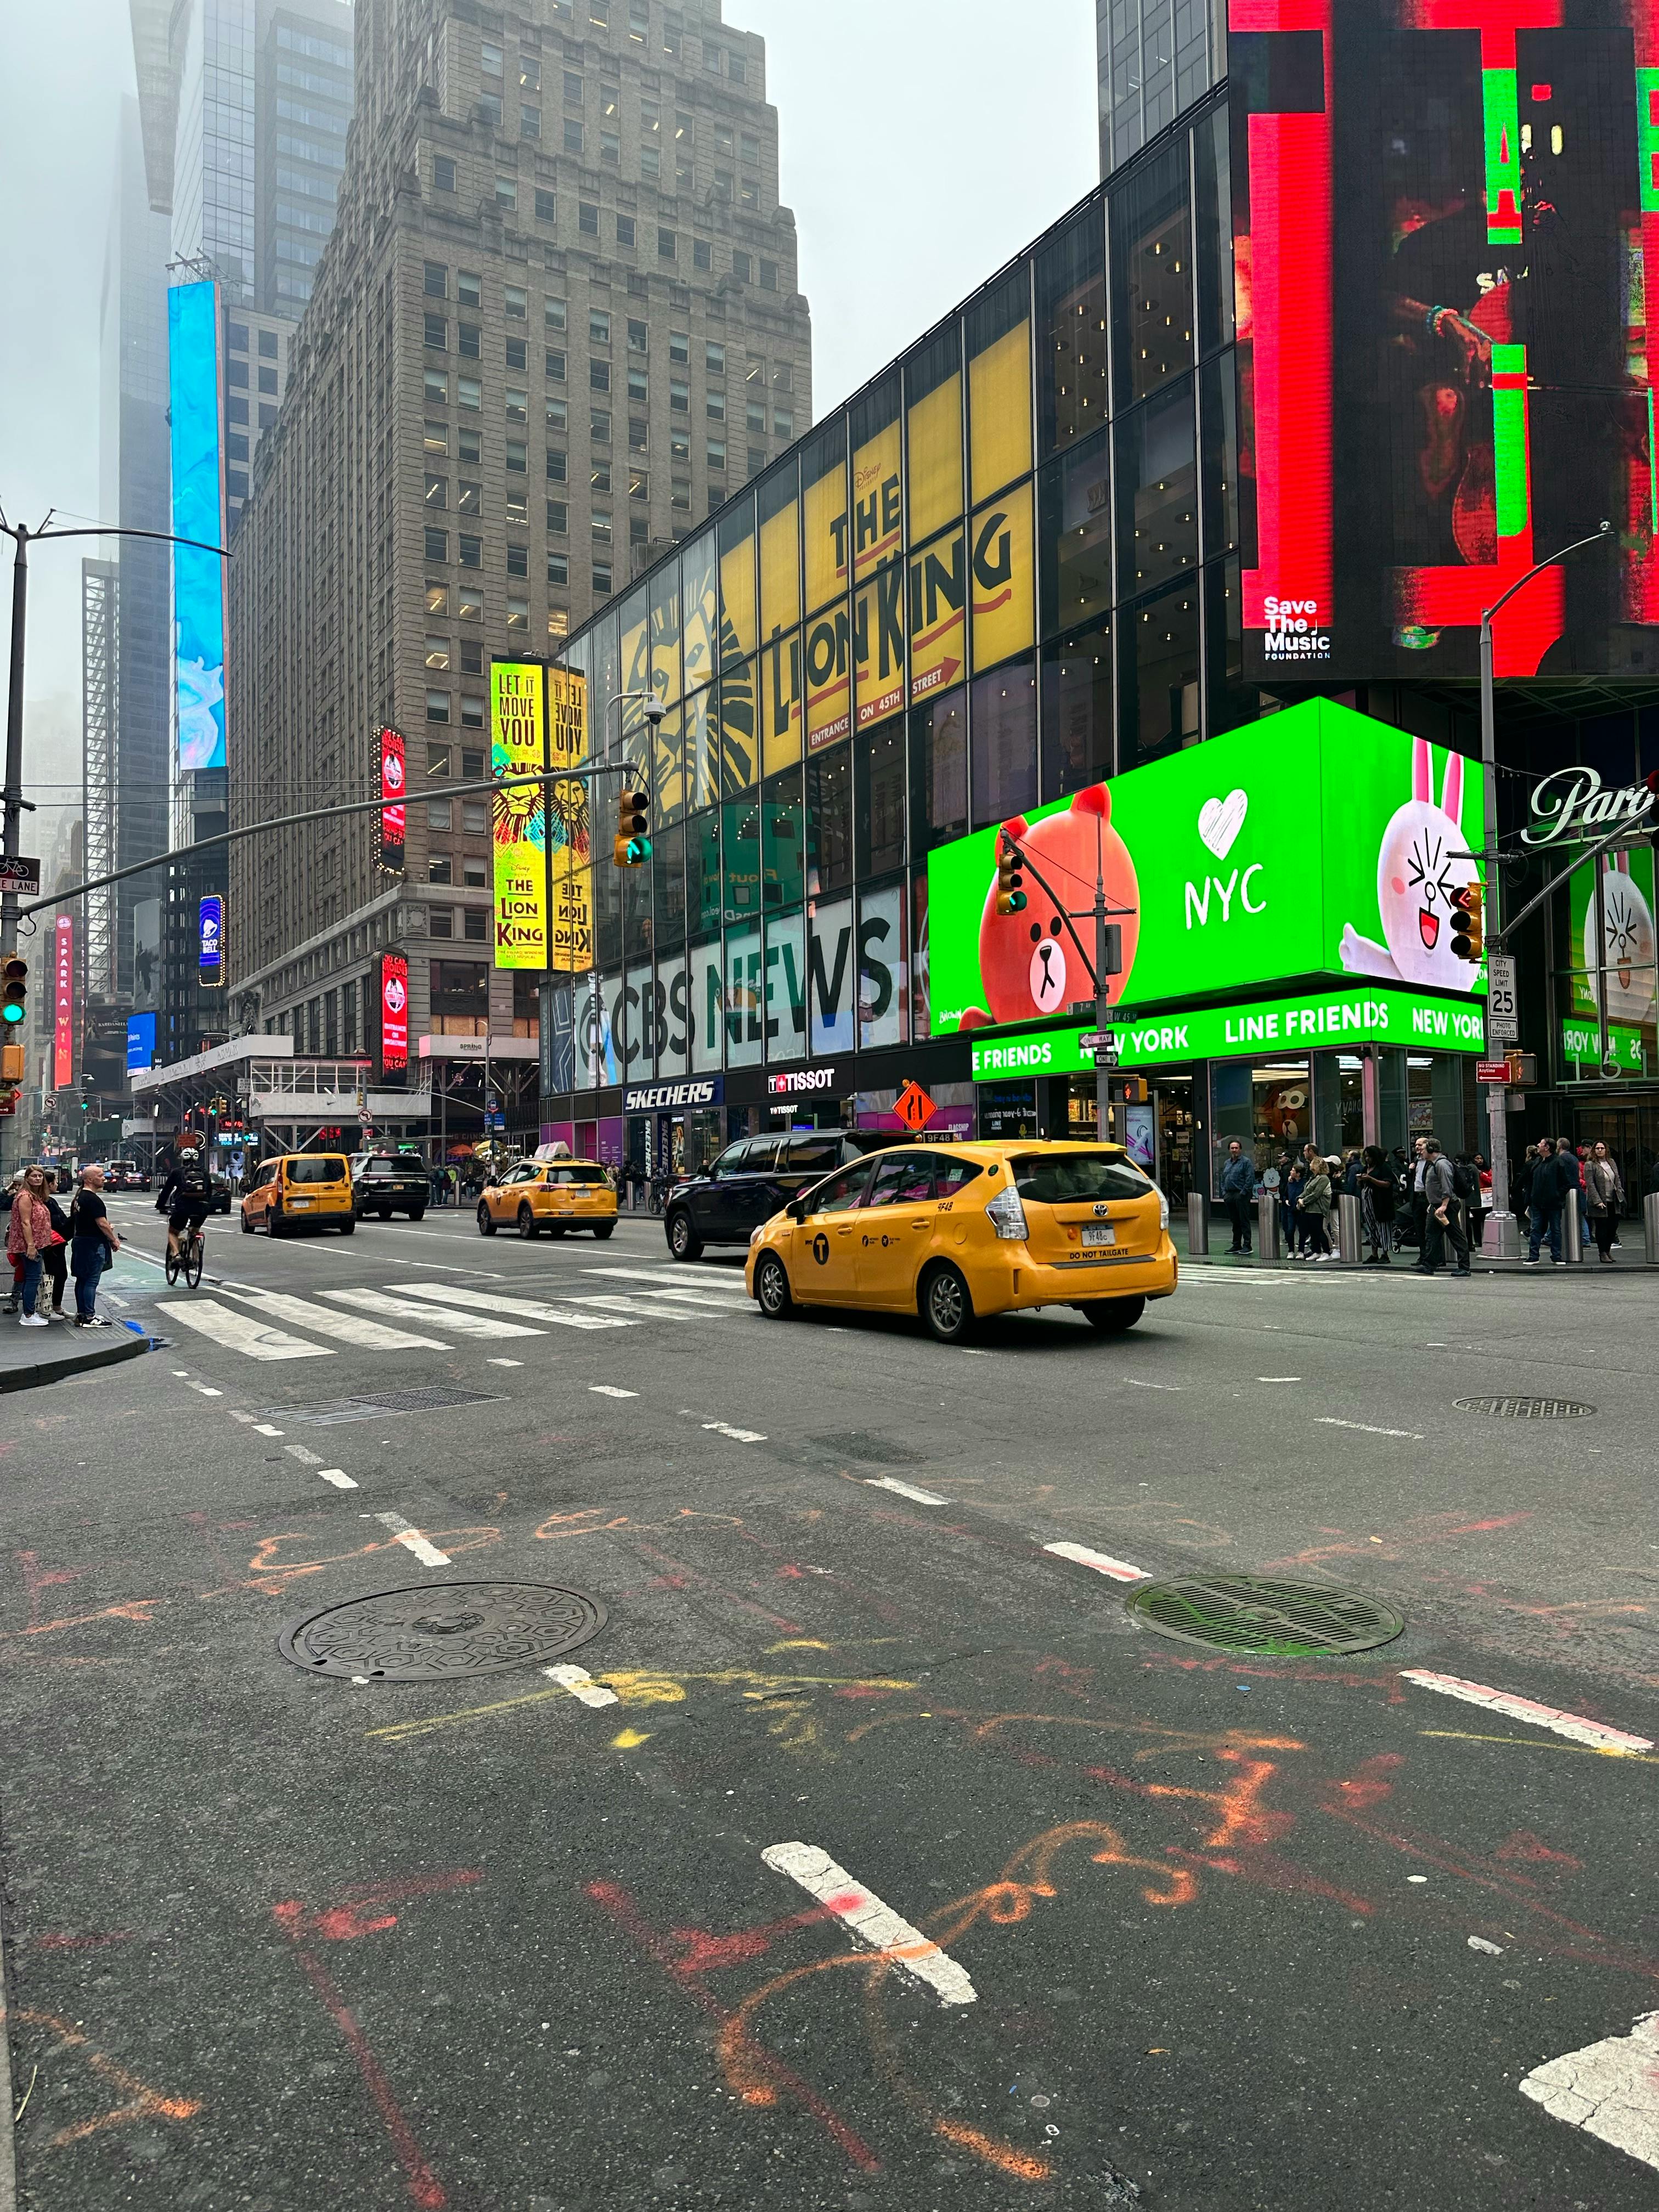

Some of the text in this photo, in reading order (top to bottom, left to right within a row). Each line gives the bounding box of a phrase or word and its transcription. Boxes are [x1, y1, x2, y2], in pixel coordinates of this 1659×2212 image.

[830, 473, 900, 569] THE
[1264, 597, 1317, 614] Save
[774, 512, 1012, 737] LION KING
[1264, 615, 1308, 633] The
[1264, 633, 1330, 651] Music
[499, 674, 534, 695] LET IT
[499, 696, 534, 718] MOVE
[811, 669, 942, 746] ENTRANCE ON 45TH STREET
[500, 718, 534, 747] YOU
[12, 881, 36, 891] LANE
[506, 879, 533, 892] THE
[1184, 863, 1267, 930] NYC
[501, 898, 538, 919] LION
[201, 939, 218, 947] TACO
[497, 922, 543, 947] KING
[202, 946, 218, 954] BELL
[1493, 969, 1509, 978] SPEED
[58, 937, 69, 1060] SPARK A WIN
[612, 917, 892, 1065] CBS NEWS
[1080, 1003, 1084, 1012] 7
[1492, 990, 1513, 1013] 25
[939, 1008, 962, 1024] BROWN
[1114, 1012, 1120, 1021] W
[1122, 1013, 1130, 1022] 45
[984, 1042, 1052, 1070] FRIENDS
[1080, 1034, 1125, 1059] NW
[1131, 1025, 1189, 1053] YORK
[1224, 1013, 1279, 1043] LINE
[1286, 1001, 1389, 1036] FRIENDS
[1412, 1007, 1448, 1035] NEW
[1492, 1029, 1515, 1037] ENFORCED
[785, 1068, 835, 1091] TISSOT
[625, 1081, 714, 1110] SKECHERS
[777, 1104, 798, 1114] TISSOT
[948, 1123, 969, 1132] FLAGSHIP
[927, 1133, 950, 1142] 9F48
[937, 1201, 954, 1212] 9F48
[1097, 1249, 1128, 1257] TAILGATE
[42, 1292, 52, 1300] 197
